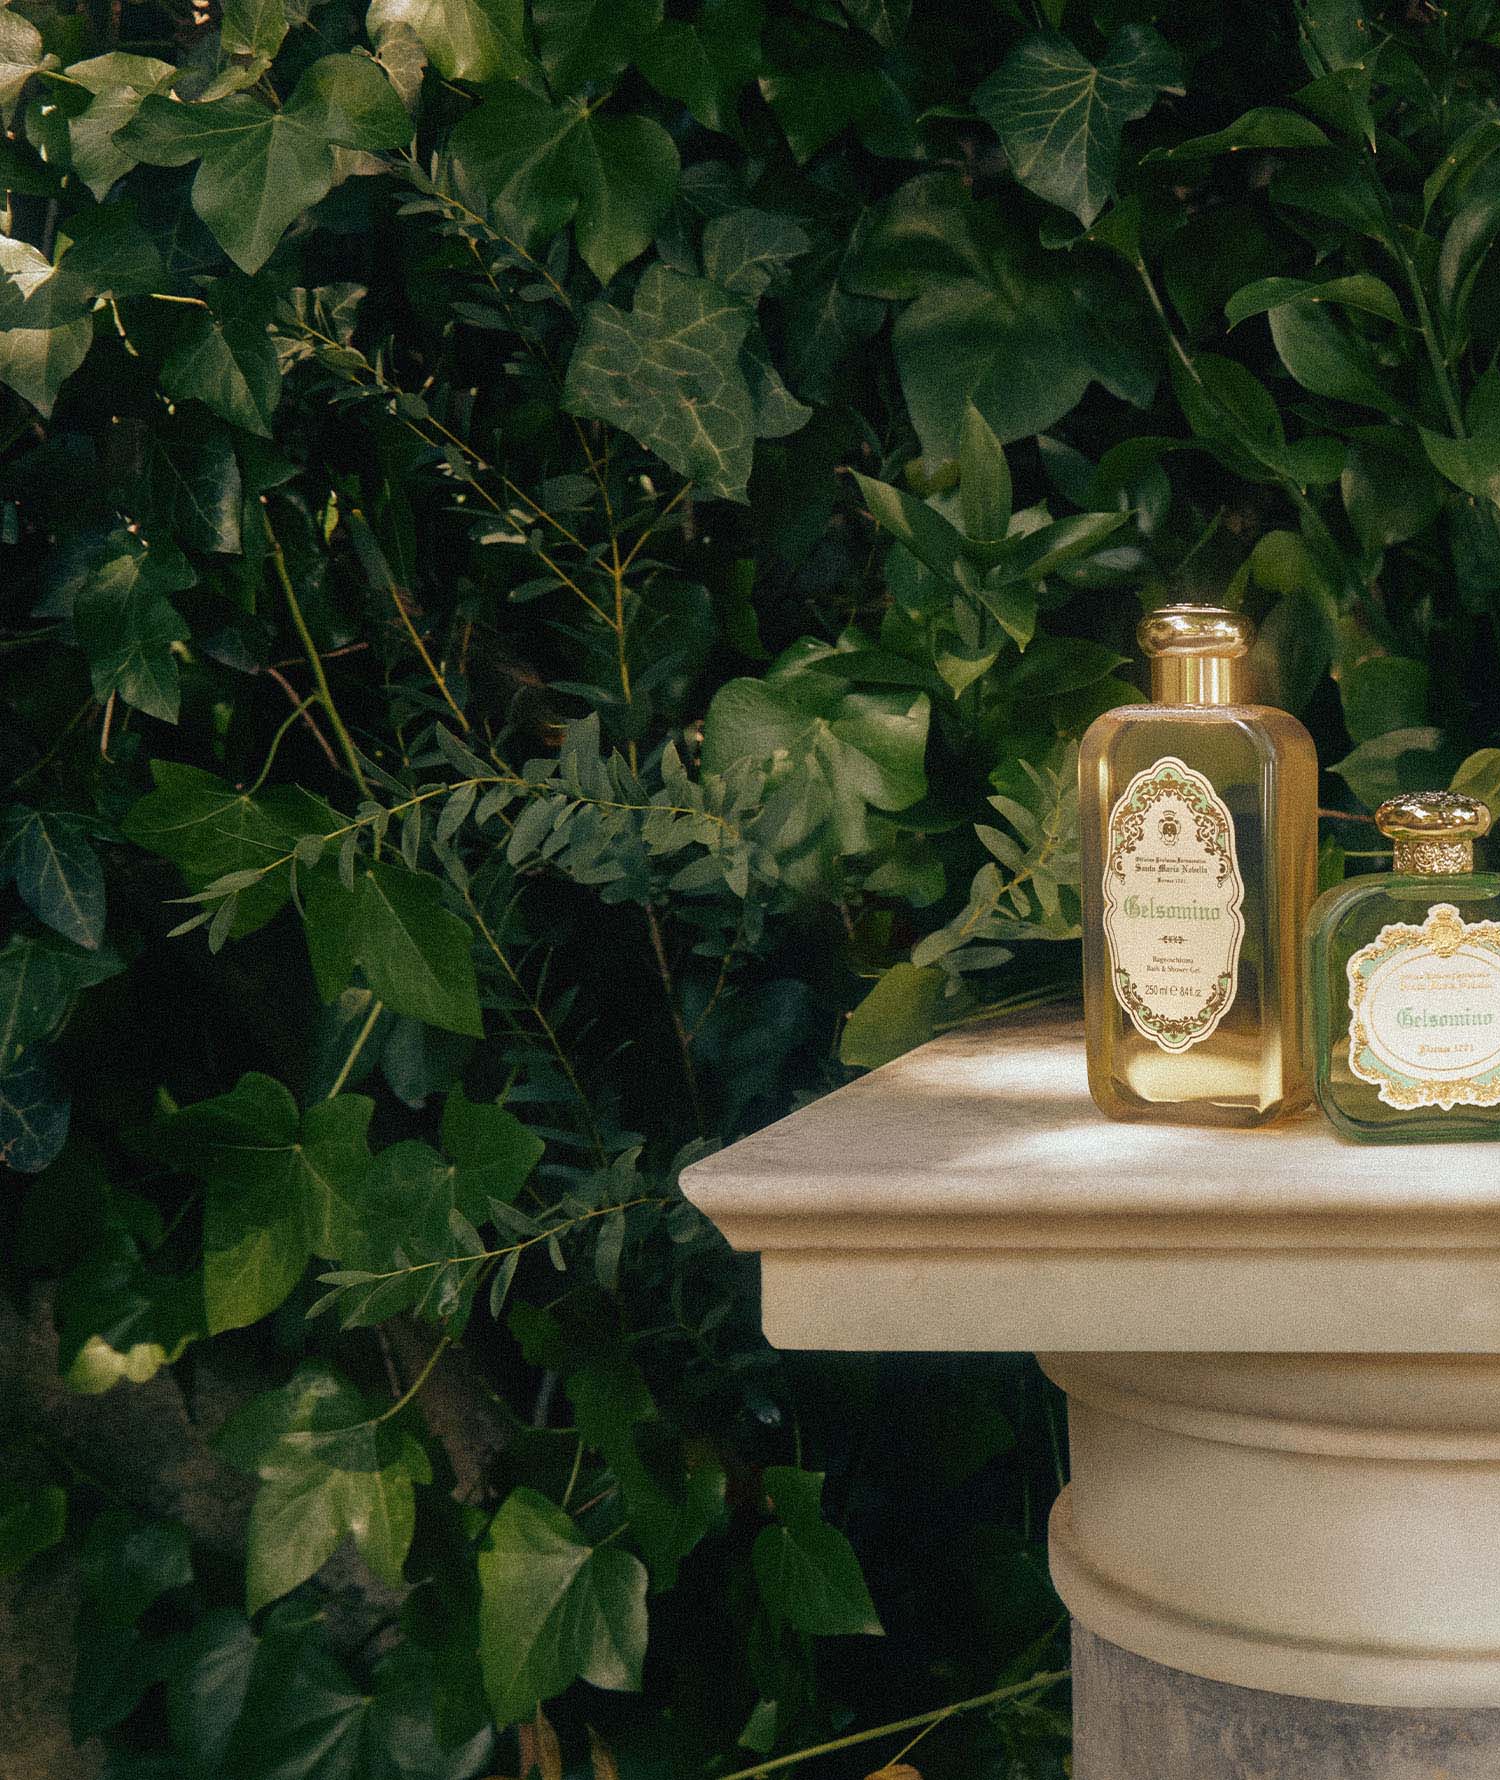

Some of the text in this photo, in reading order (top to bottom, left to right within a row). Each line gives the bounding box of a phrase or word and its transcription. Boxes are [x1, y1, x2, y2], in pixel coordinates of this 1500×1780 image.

[1135, 863, 1208, 874] Santa Maria Novella
[1123, 894, 1220, 920] Gelsomino
[1167, 965, 1188, 973] Shower
[1145, 984, 1158, 995] 250
[1159, 985, 1168, 995] ml
[1397, 1007, 1494, 1029] Gelsomino
